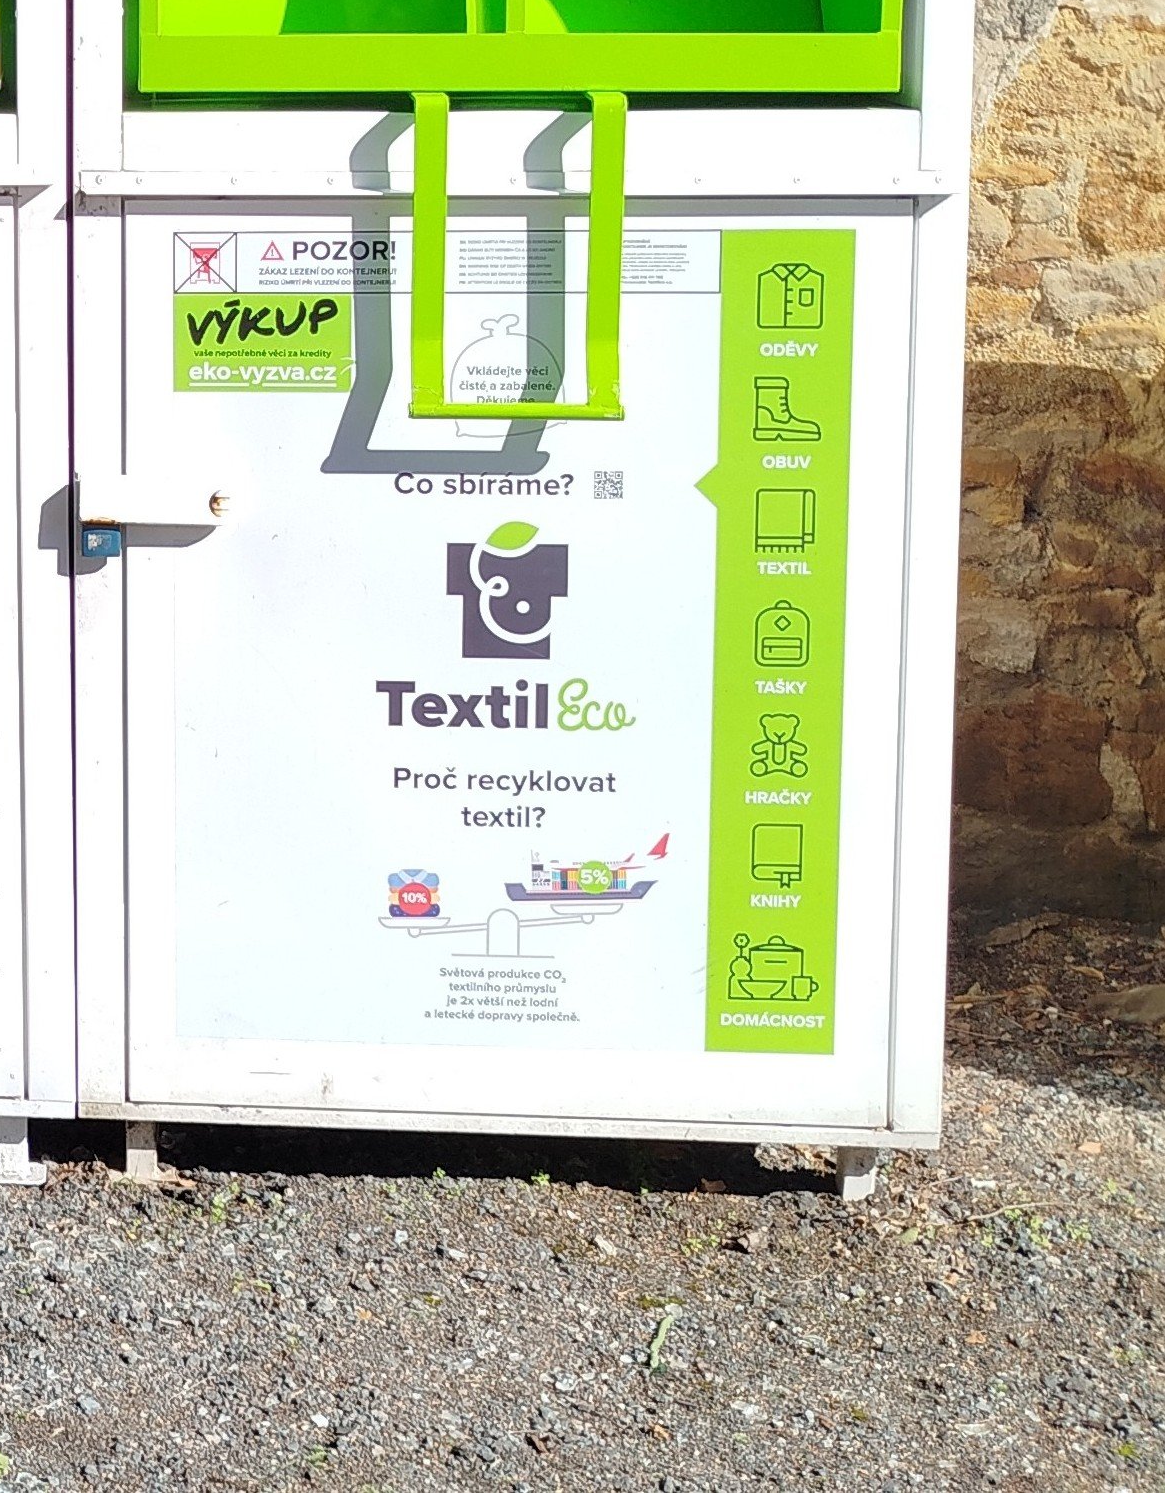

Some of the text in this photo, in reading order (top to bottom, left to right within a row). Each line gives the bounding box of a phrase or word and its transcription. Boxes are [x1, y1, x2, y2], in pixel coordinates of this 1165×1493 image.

[292, 240, 396, 261] POZOR!
[258, 266, 287, 276] ZÁKAZ
[289, 267, 319, 276] LEZENÍ
[321, 268, 335, 276] DO
[187, 298, 338, 346] VÝKUP
[194, 349, 213, 357] vaše
[215, 349, 267, 358] nepotřebné
[268, 349, 286, 357] věci
[299, 349, 332, 358] kredity
[759, 340, 818, 358] ODĚVY
[189, 361, 336, 384] eko-vyzva.cz
[466, 366, 549, 378] Vkládejte věci
[459, 381, 556, 391] čisté a zabalené.
[762, 455, 812, 470] OBUV
[394, 472, 574, 496] Co sbíráme?
[757, 561, 812, 575] TEXTIL
[755, 678, 808, 695] TAŠKY
[376, 678, 549, 729] Textil
[393, 766, 616, 797] Proč recyklovat
[745, 788, 812, 805] HRAČKY
[461, 806, 546, 828] textil?
[580, 869, 609, 885] 5%
[401, 891, 428, 904] 10%
[750, 894, 801, 909] KNIHY
[439, 967, 485, 978] Světová
[487, 968, 541, 980] produkce
[448, 982, 557, 995] textilního průmyslu
[446, 995, 559, 1007] je 2x větší než lodní
[434, 1009, 475, 1019] letecké
[477, 1010, 524, 1022] dopravy
[526, 1011, 581, 1022] společně.
[720, 1011, 826, 1028] DOMÁCNOST
